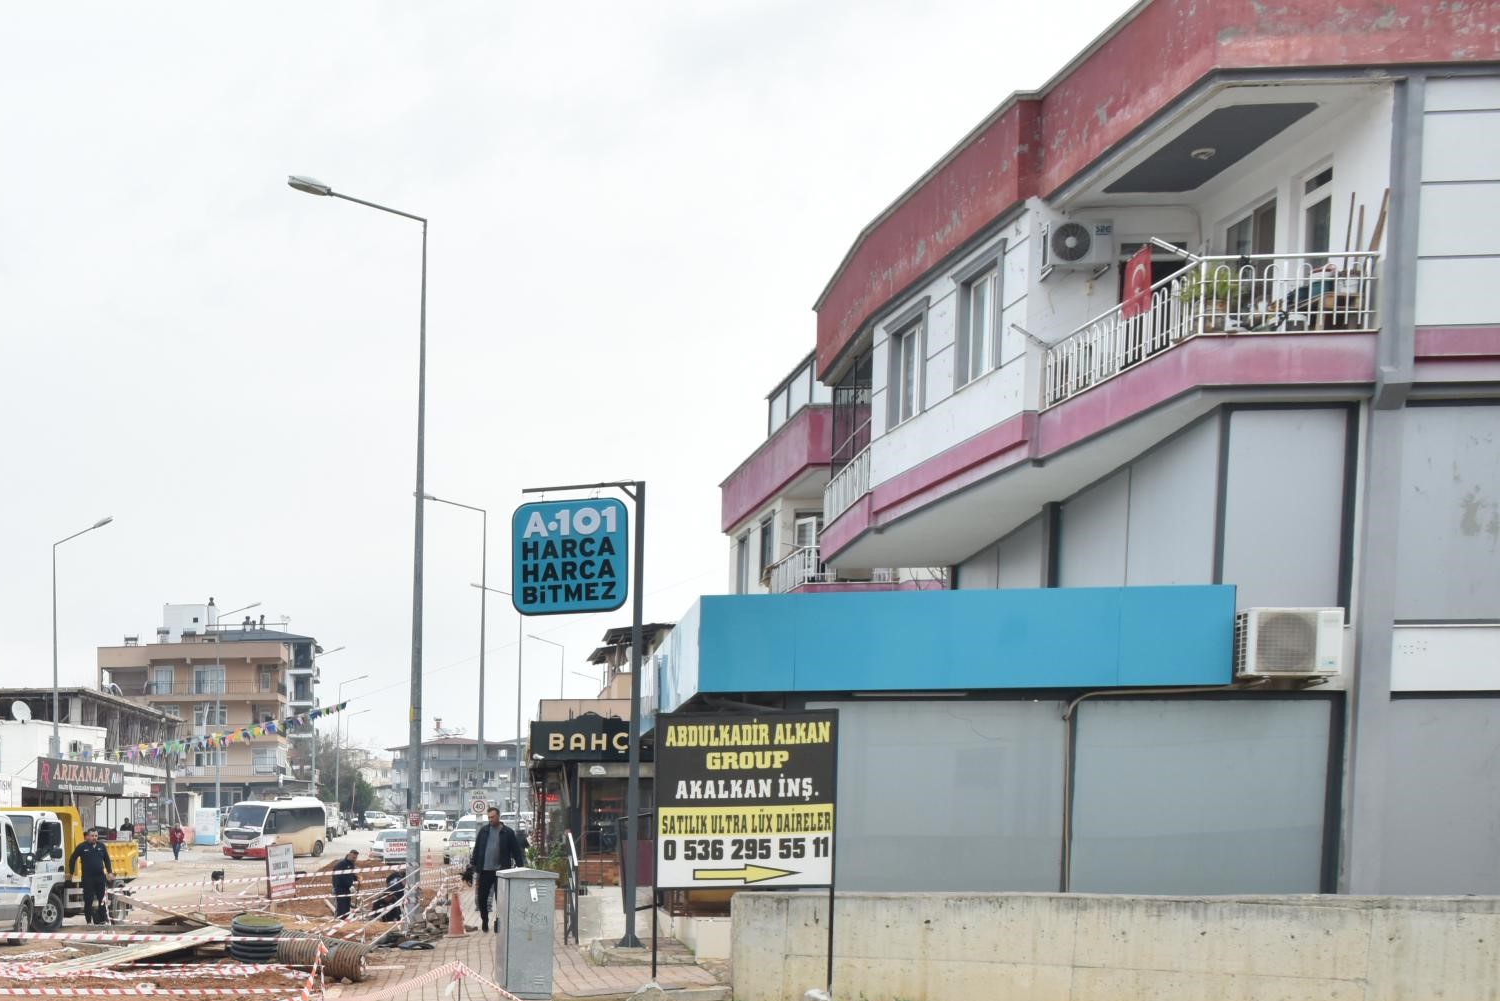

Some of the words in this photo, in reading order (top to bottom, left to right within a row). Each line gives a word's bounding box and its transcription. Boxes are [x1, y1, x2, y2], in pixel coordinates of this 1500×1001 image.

[522, 536, 616, 561] HARCA
[522, 559, 616, 583] HARCA
[665, 718, 771, 748] ABDULKADİR
[773, 721, 831, 745] ALKAN
[705, 750, 789, 770] GROUP
[675, 778, 773, 800] AKALKAN
[778, 773, 819, 801] İNŞ.
[662, 814, 708, 835] SATILIK
[710, 813, 749, 834] ULTRA
[751, 808, 773, 834] LÜX
[776, 808, 832, 832] DAİRELER
[663, 839, 677, 861] 0
[683, 839, 724, 861] 536
[731, 838, 772, 860] 295
[778, 837, 806, 859] 55
[812, 837, 829, 858] 11
